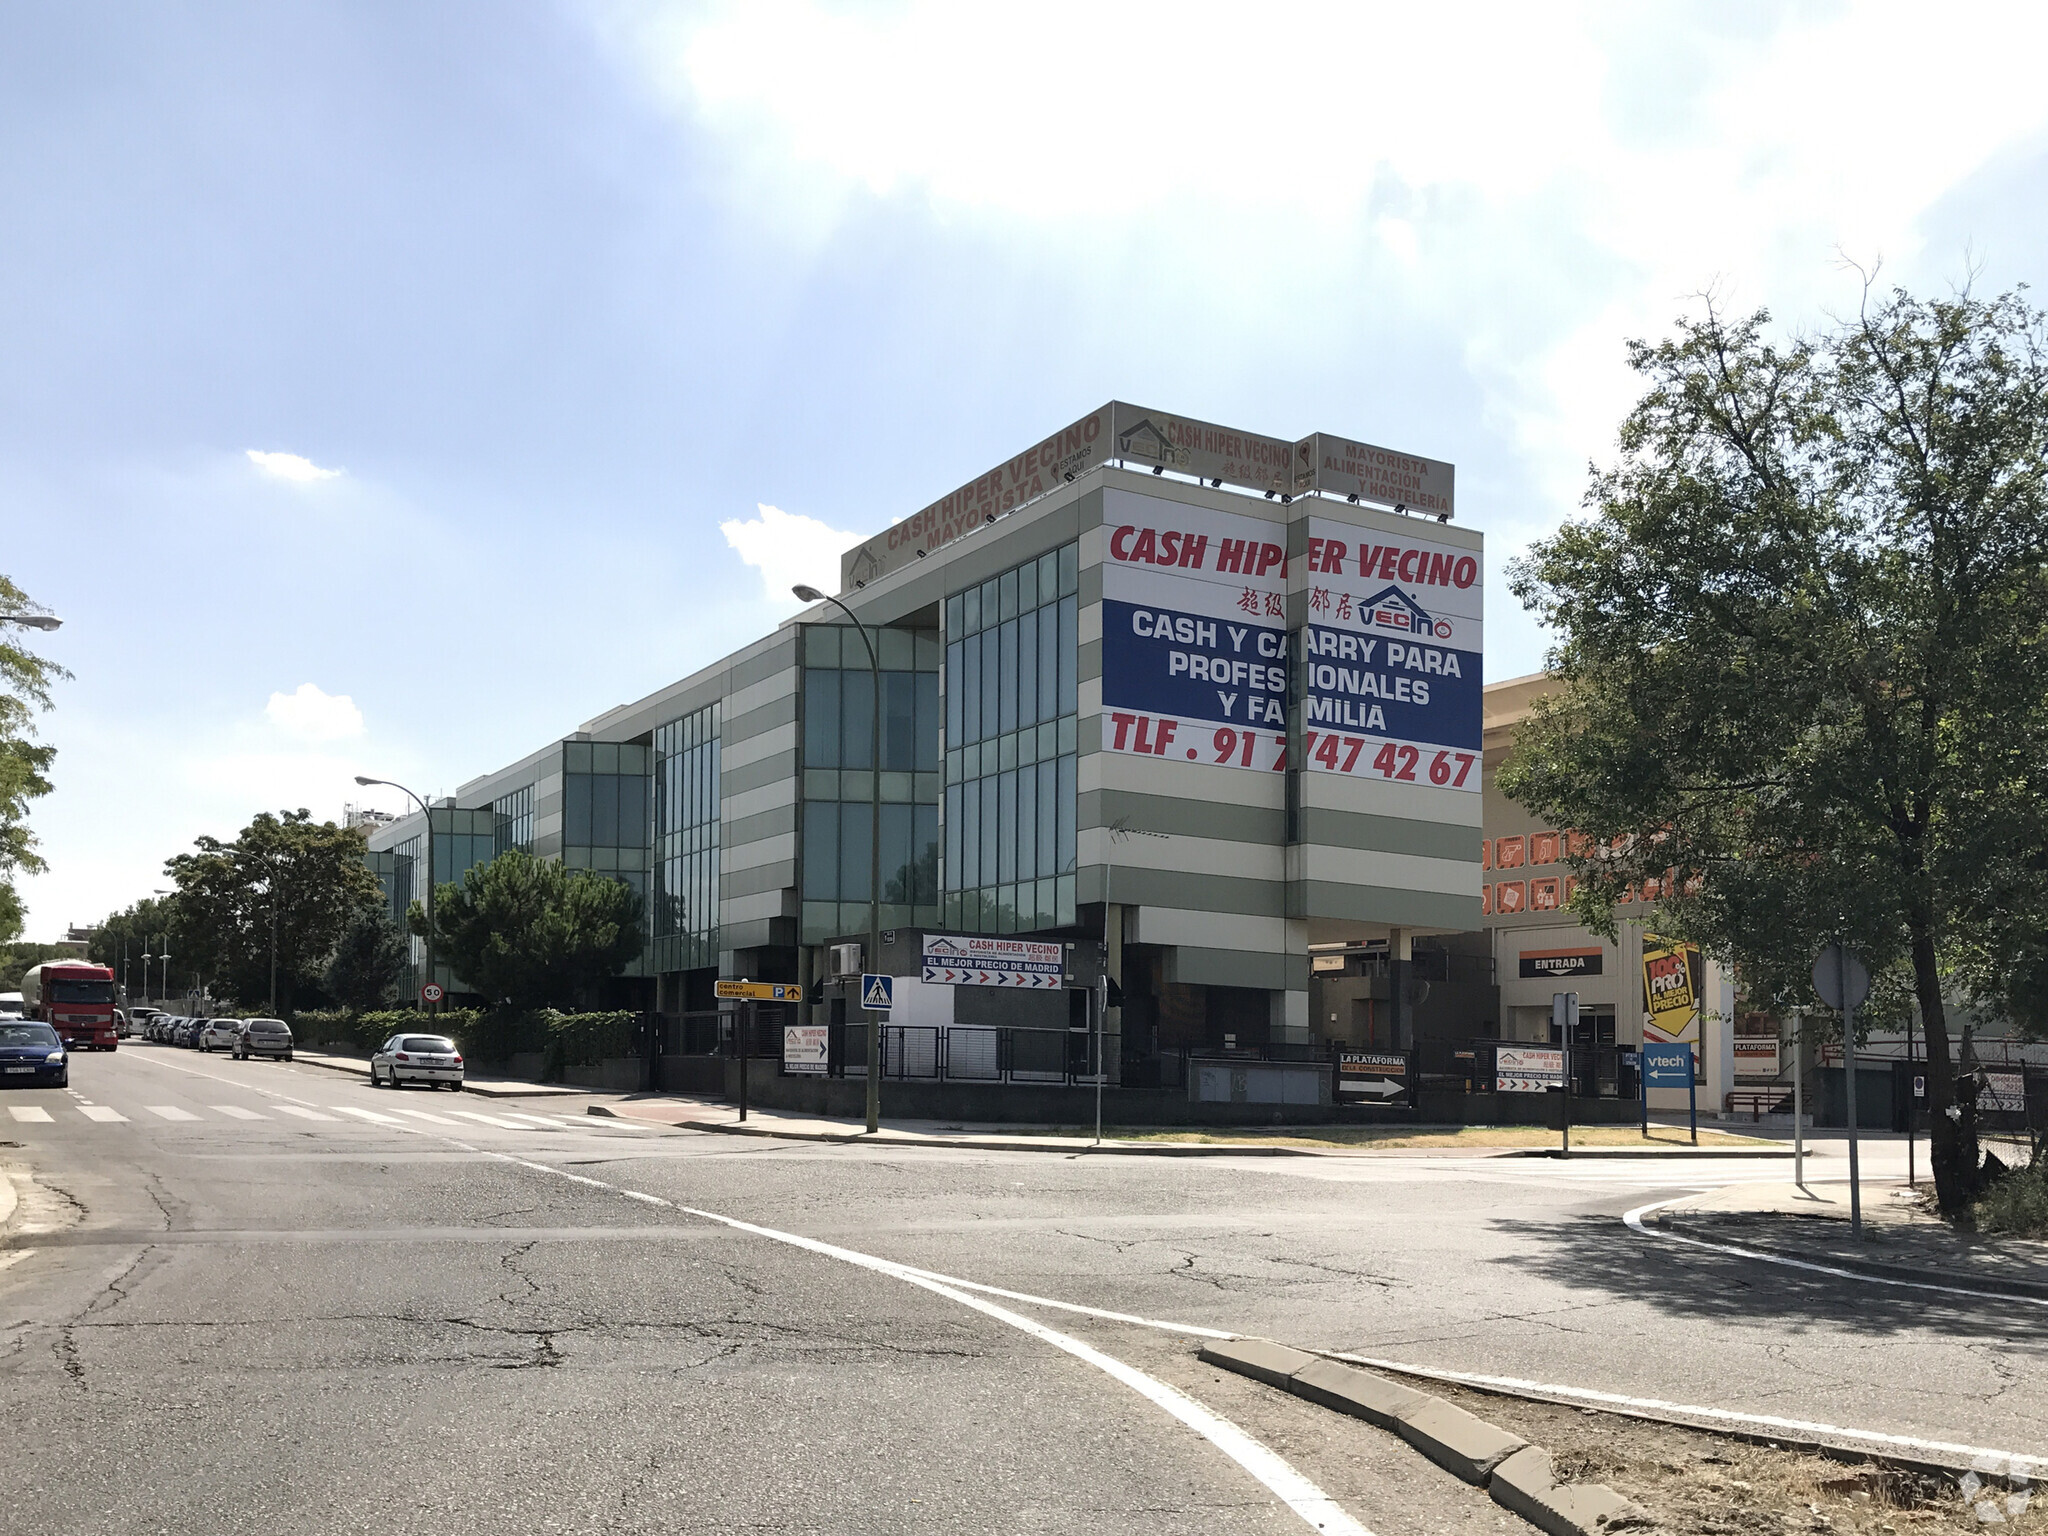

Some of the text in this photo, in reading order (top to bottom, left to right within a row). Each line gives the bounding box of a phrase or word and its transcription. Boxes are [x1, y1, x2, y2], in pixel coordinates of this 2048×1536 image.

[1060, 445, 1092, 470] ESTAMOS
[1168, 421, 1290, 470] CASH HIPER VECINO
[1324, 456, 1421, 490] ALIMENTACIÓN
[1345, 445, 1428, 476] MAYORISTA
[887, 415, 1100, 551] CASH HIPER VECINO
[1358, 478, 1449, 512] Y HOSTELERÍA
[926, 473, 1044, 551] MAYORISTA
[1110, 525, 1477, 589] CASH HIPER VECINO
[1132, 610, 1462, 679] CASH Y CARRY PARA
[1168, 650, 1430, 706] PROFESIONALES
[1217, 690, 1387, 731] Y FAMILIA
[1213, 727, 1256, 768] 91
[1272, 731, 1366, 773] 747
[1373, 743, 1420, 782] 42
[1429, 751, 1476, 788] 67
[969, 940, 1059, 955] CASH HIPER VECINO
[927, 957, 1059, 973] EL MEJOR PRECIO DE MADRID
[1535, 957, 1585, 970] ENTRADA
[426, 988, 440, 997] 50
[775, 987, 783, 997] P
[1651, 973, 1684, 994] PRO
[1652, 986, 1688, 1002] AL MEJOR
[1653, 994, 1689, 1012] PRECIO
[1341, 1055, 1405, 1066] LA PLATAFORMA
[1647, 1055, 1685, 1068] vtech
